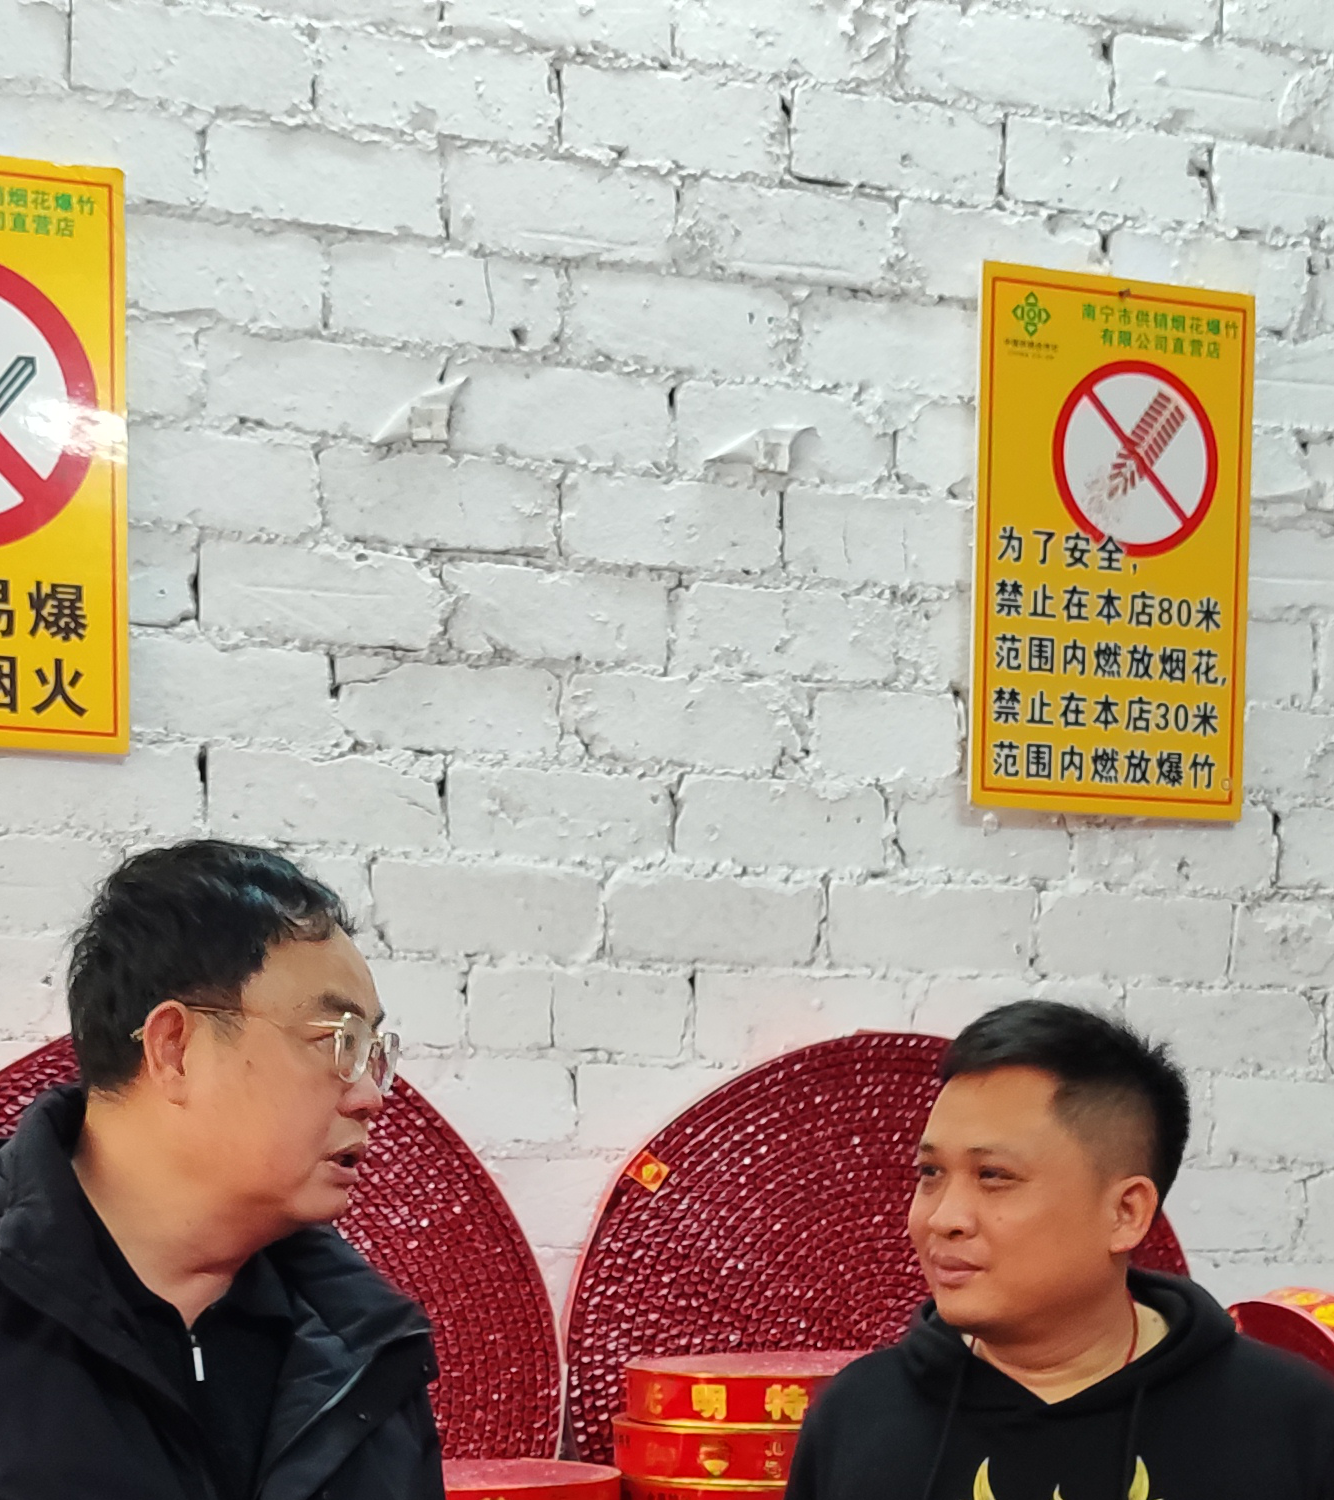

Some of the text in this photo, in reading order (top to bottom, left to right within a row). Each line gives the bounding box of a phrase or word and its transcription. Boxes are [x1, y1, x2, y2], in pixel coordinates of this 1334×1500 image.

[1082, 304, 1239, 340] 南宁市供销烟花爆竹
[1101, 328, 1221, 359] 有限公司直营店
[994, 580, 1222, 632] 禁止在本店80米
[992, 687, 1219, 737] 禁止在本店30米
[992, 741, 1216, 790] 范围内燃放爆竹
